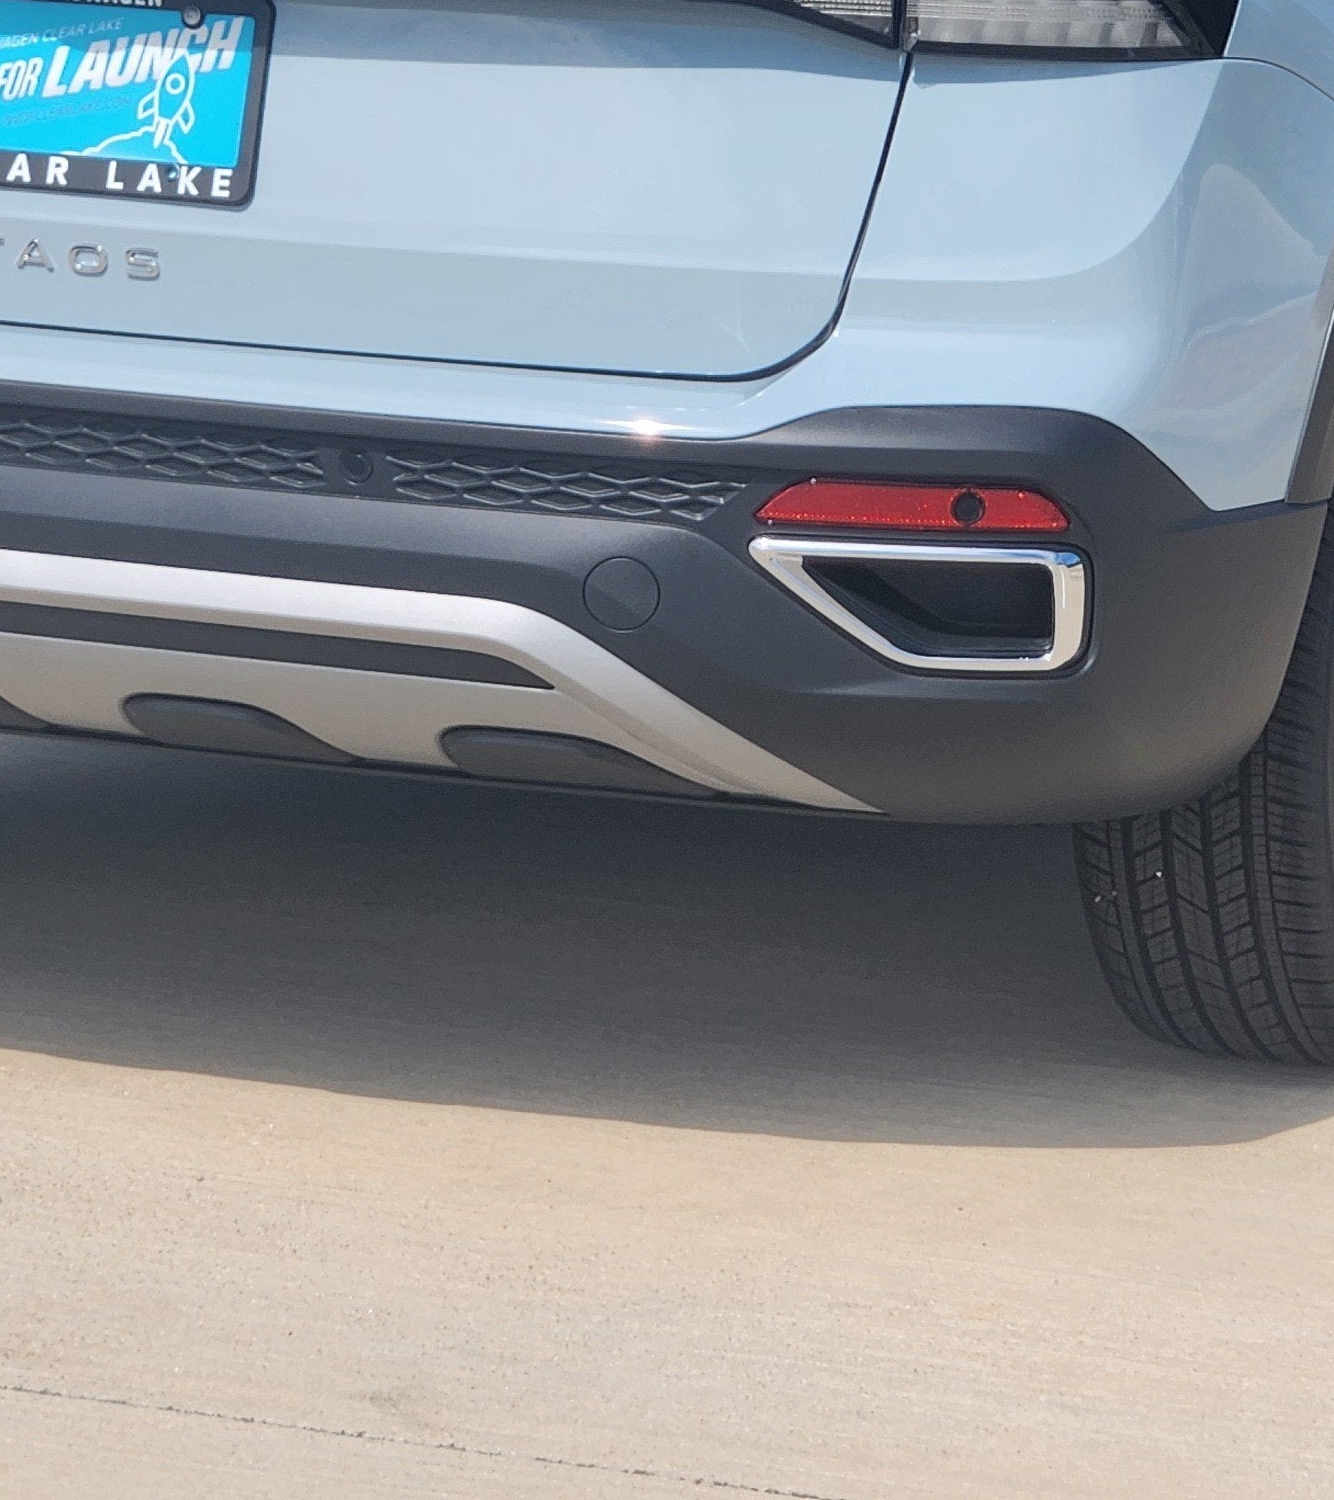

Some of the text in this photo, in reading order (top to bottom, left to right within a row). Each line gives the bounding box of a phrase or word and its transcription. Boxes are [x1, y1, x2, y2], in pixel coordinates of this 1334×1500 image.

[42, 23, 85, 42] CLEAR
[88, 16, 126, 35] LAKE
[41, 15, 245, 98] LAUNCH
[106, 160, 234, 199] LAKE
